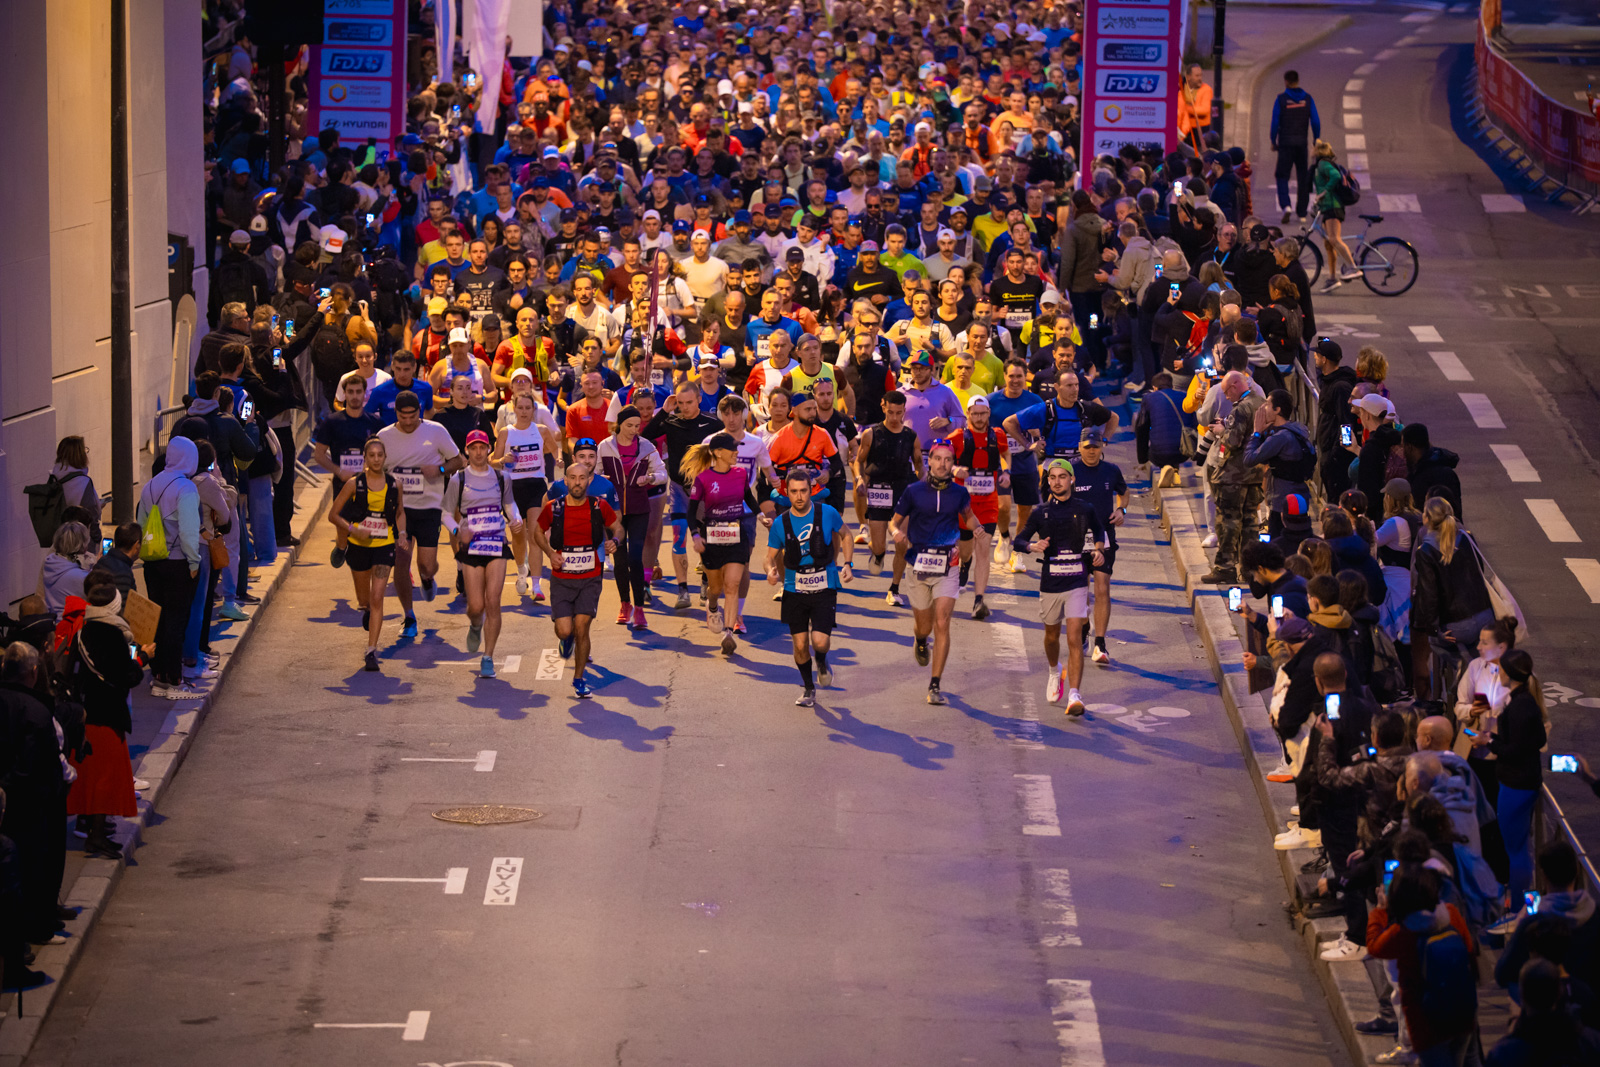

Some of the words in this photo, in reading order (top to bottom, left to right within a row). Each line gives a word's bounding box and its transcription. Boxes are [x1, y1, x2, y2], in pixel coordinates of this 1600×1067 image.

[332, 56, 362, 70] FDJ
[1107, 76, 1138, 91] FDJ
[342, 120, 387, 128] HYUNDAI
[1002, 292, 1035, 300] Champion
[343, 458, 364, 466] 4357
[399, 477, 421, 485] 2363
[967, 479, 992, 487] 42422
[710, 530, 737, 538] 43094
[565, 555, 592, 564] 42707
[917, 556, 944, 567] 43542
[798, 575, 825, 585] 42604
[489, 858, 517, 903] PAYANT
